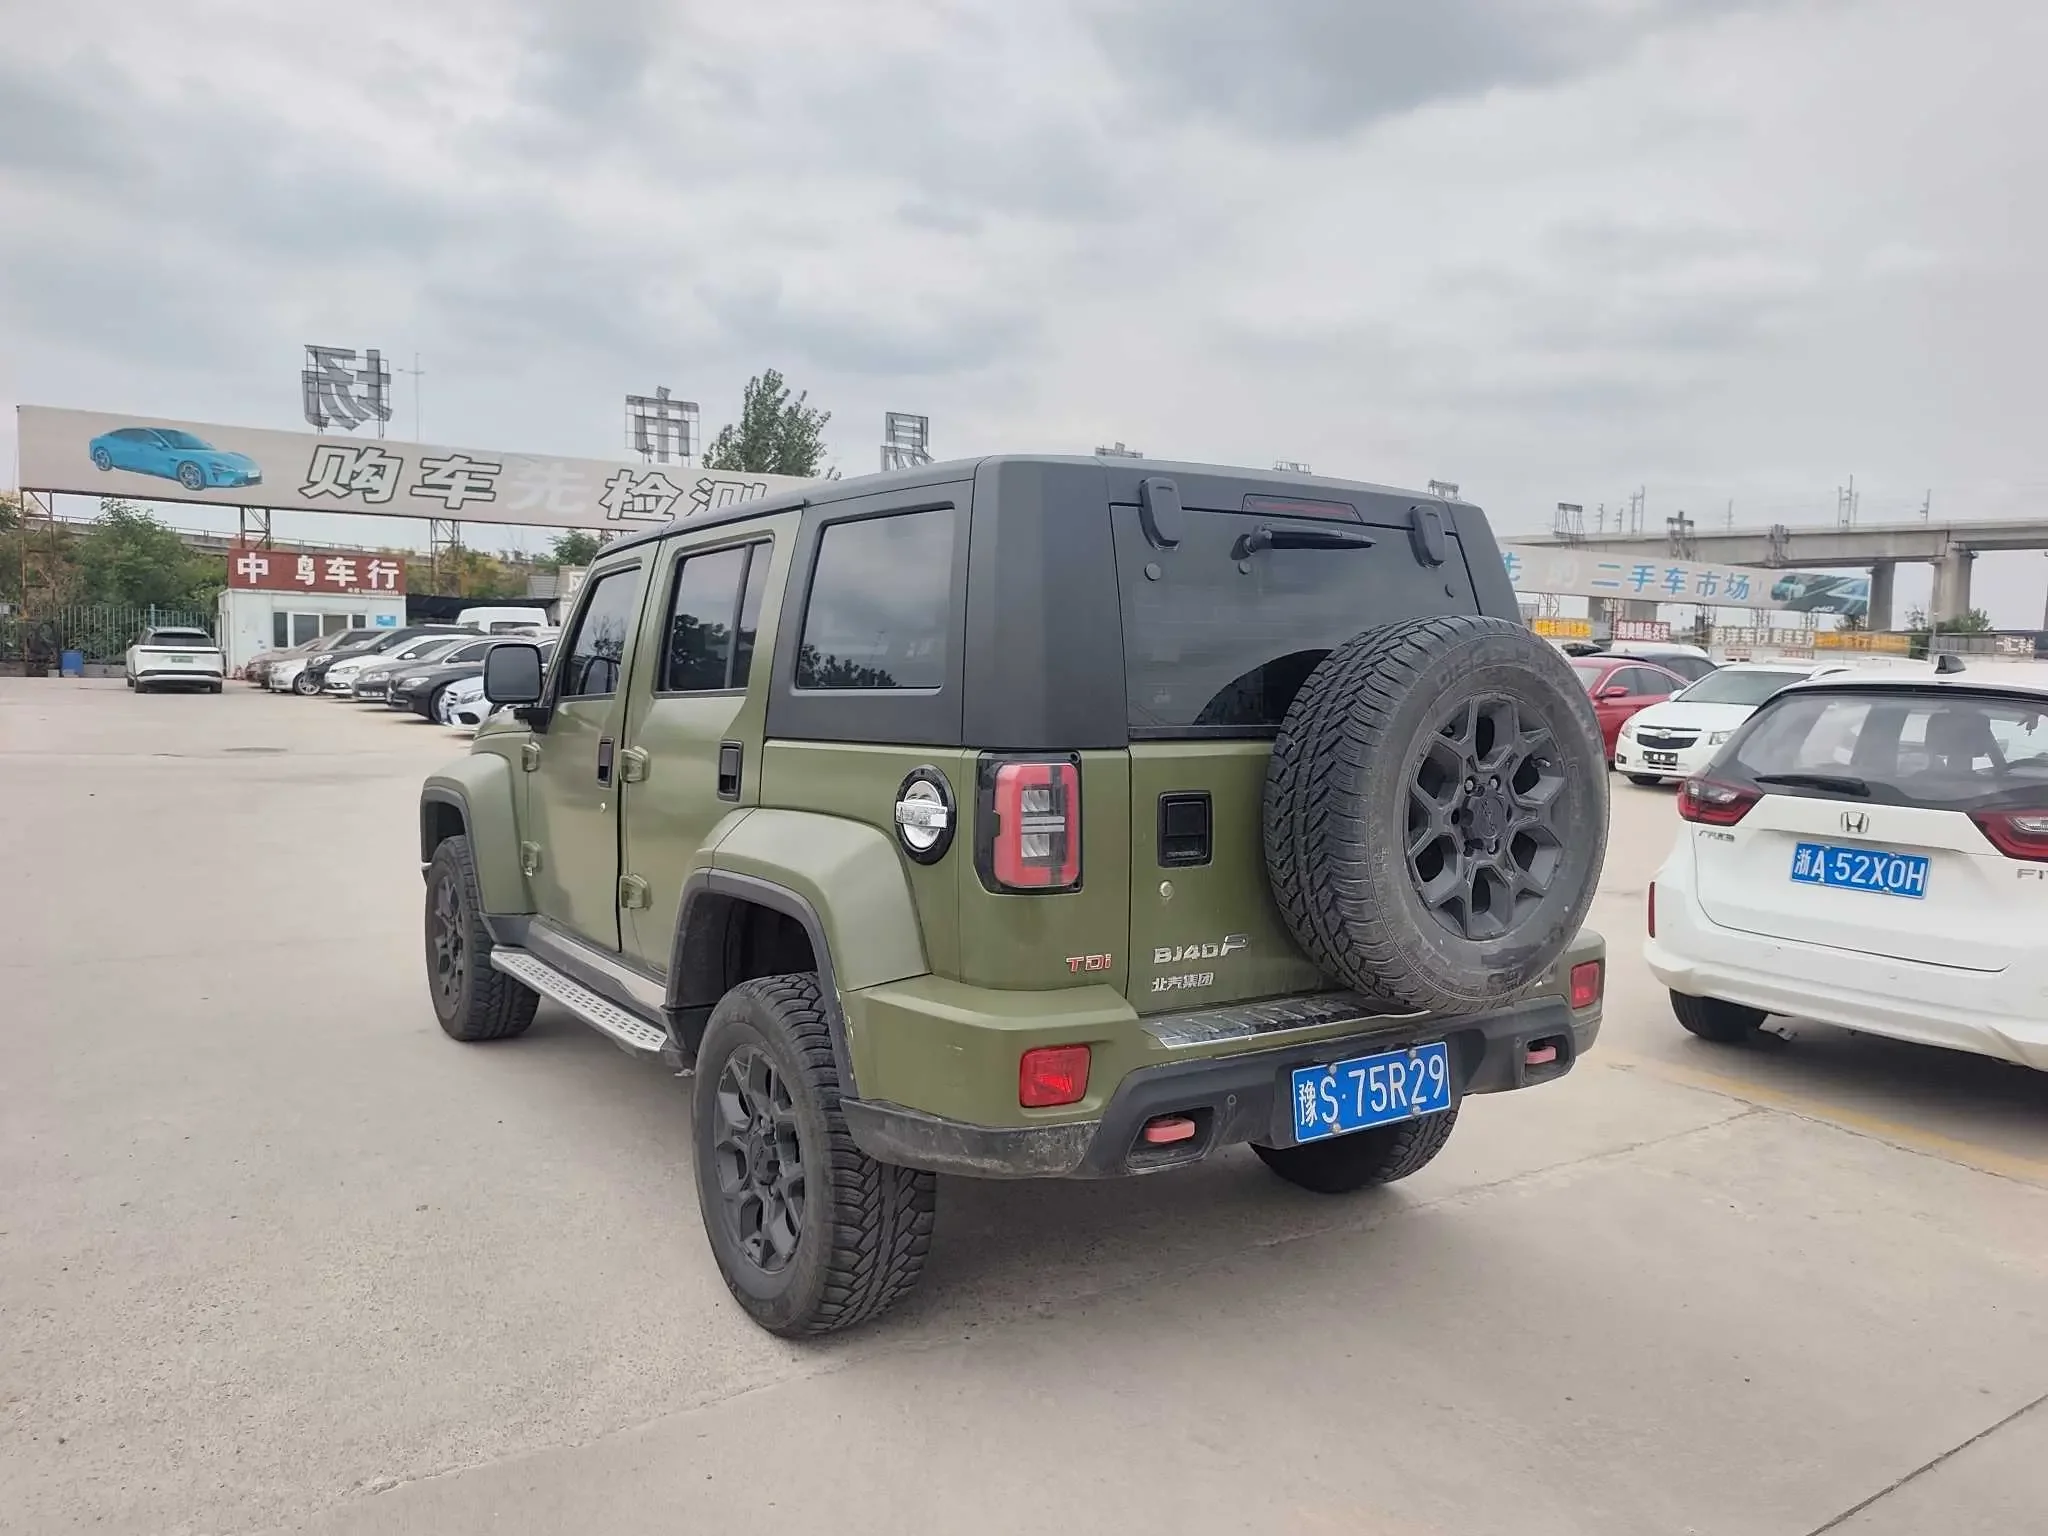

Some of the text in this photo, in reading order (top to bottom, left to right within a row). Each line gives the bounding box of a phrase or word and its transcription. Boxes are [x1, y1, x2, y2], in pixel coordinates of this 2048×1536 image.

[2017, 868, 2048, 880] FI
[1151, 972, 1214, 993] 北汽集团
[1298, 1054, 1445, 1127] 豫S·75R29
